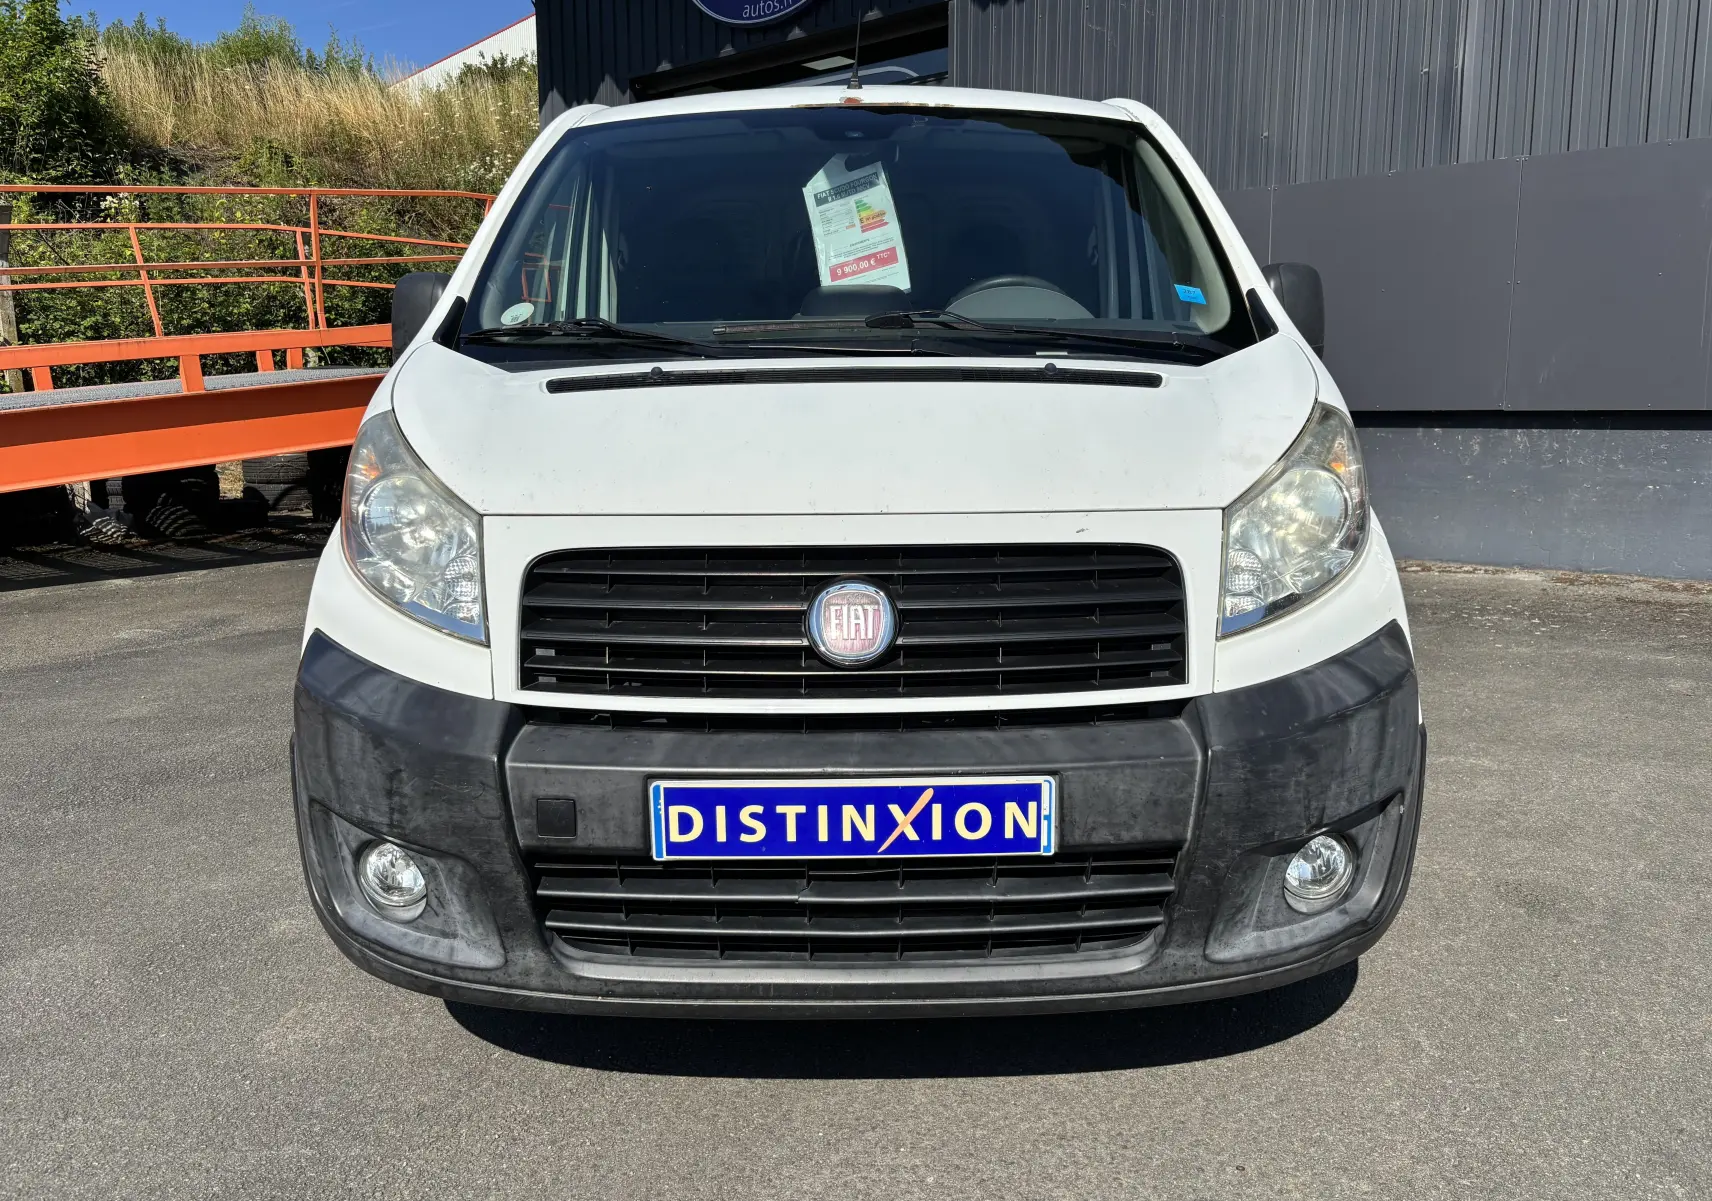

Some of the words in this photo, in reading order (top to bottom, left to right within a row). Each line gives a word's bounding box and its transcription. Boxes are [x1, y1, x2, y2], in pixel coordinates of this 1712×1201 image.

[817, 190, 830, 199] FIAT
[829, 604, 880, 641] FIAT
[668, 788, 1038, 852] DISTINXION
